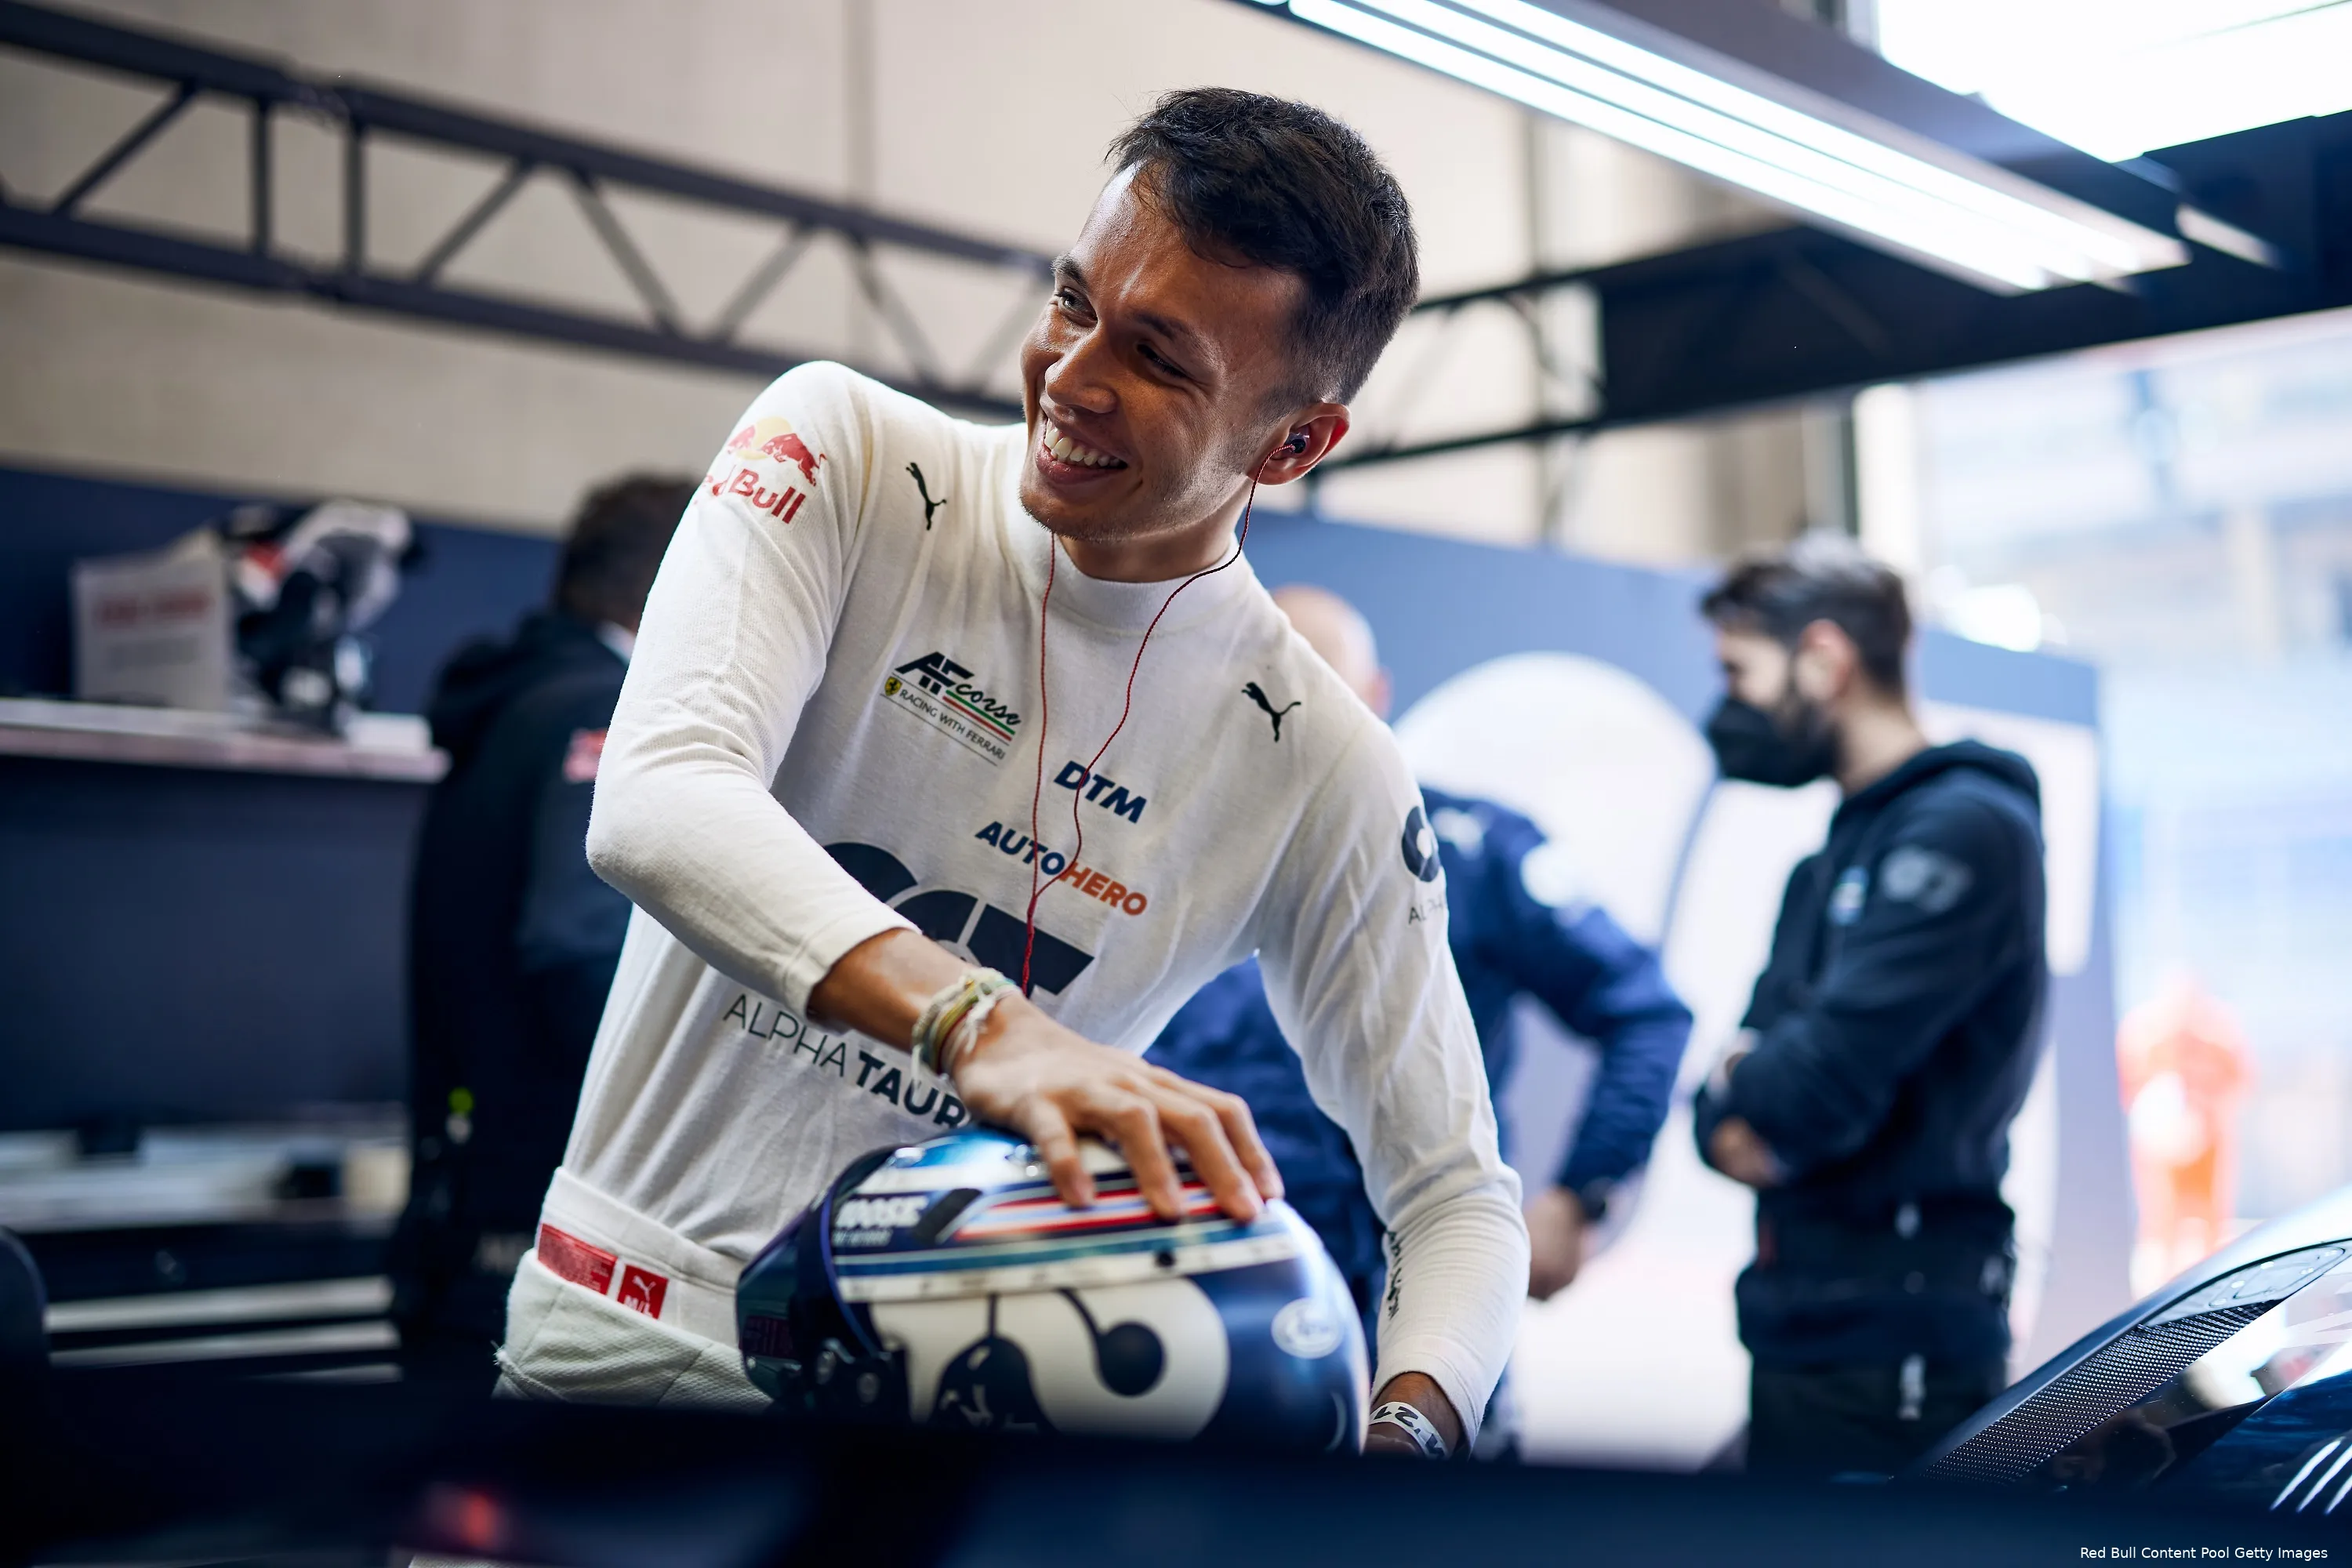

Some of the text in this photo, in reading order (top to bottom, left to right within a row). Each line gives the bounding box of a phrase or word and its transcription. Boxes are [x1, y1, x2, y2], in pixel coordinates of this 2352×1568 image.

[728, 468, 806, 524] Bull
[901, 689, 1006, 760] RACING WITH FERRARI
[955, 683, 1022, 726] corse
[1054, 760, 1147, 823] DTM
